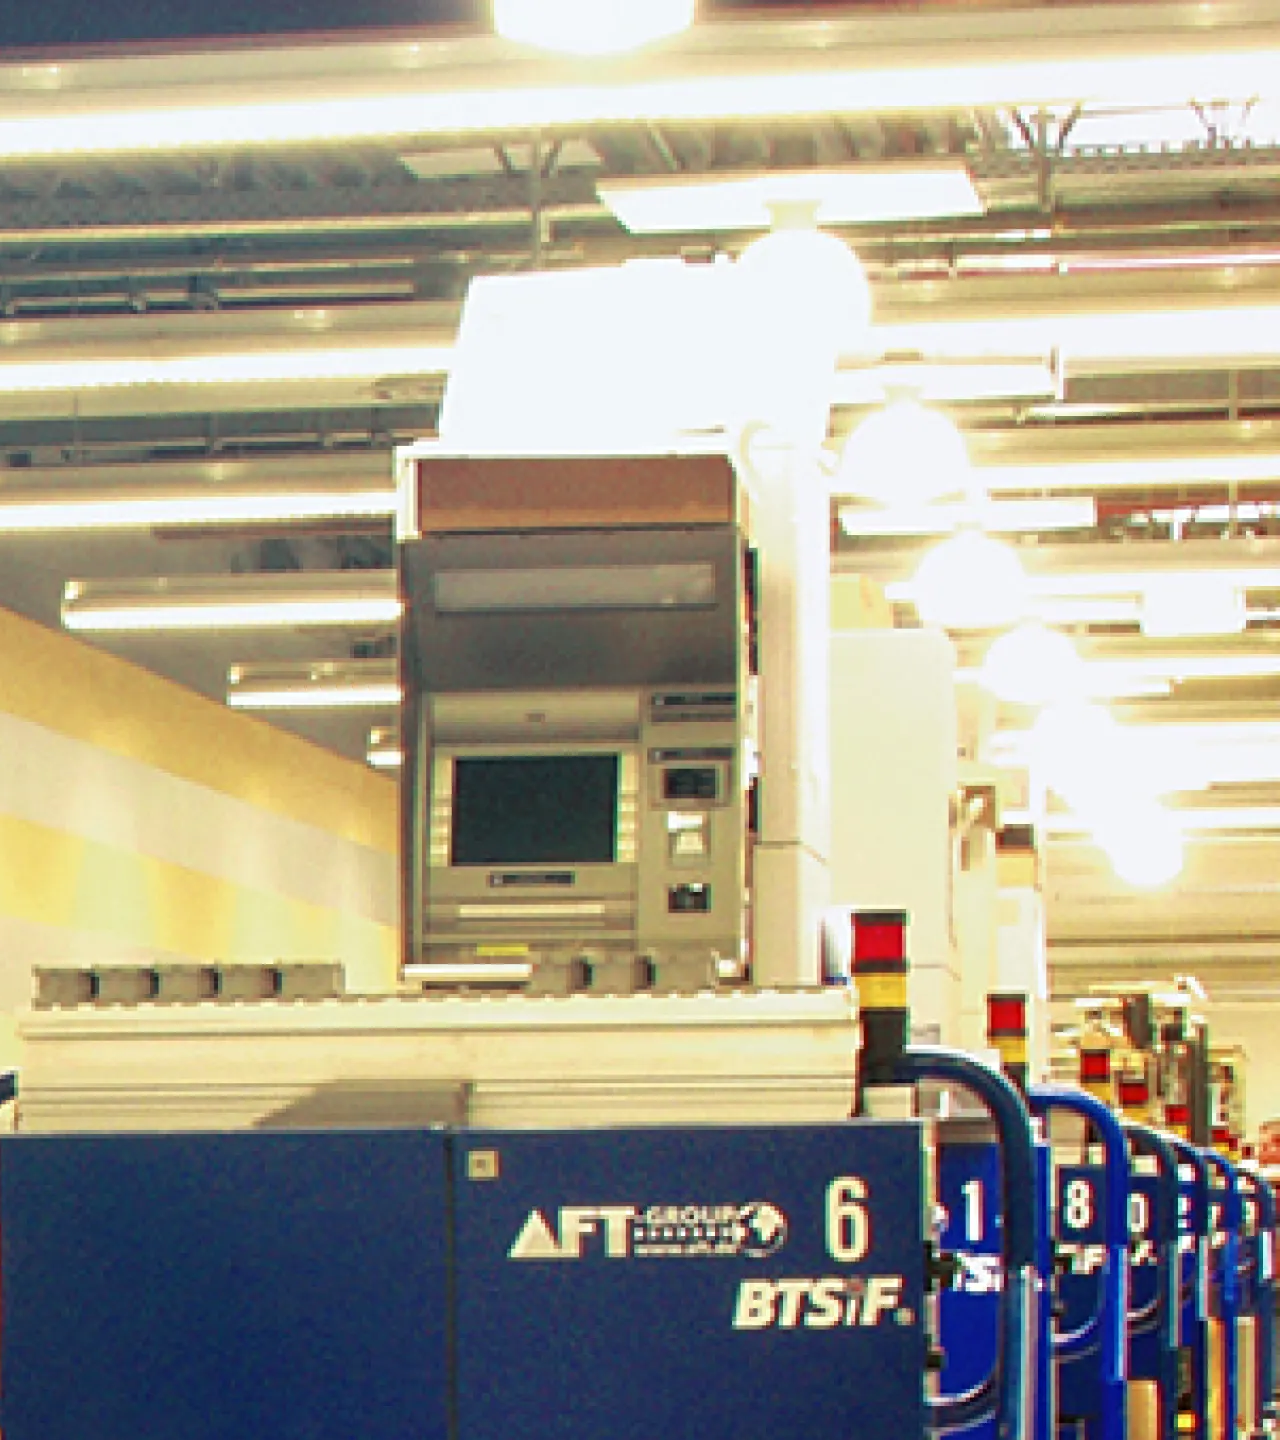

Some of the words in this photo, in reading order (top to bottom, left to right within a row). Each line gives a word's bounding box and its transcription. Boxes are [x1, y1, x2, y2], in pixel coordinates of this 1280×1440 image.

[507, 1206, 635, 1257] AFT
[826, 1176, 868, 1261] 6
[961, 1180, 983, 1241] 1
[1064, 1180, 1095, 1229] 8
